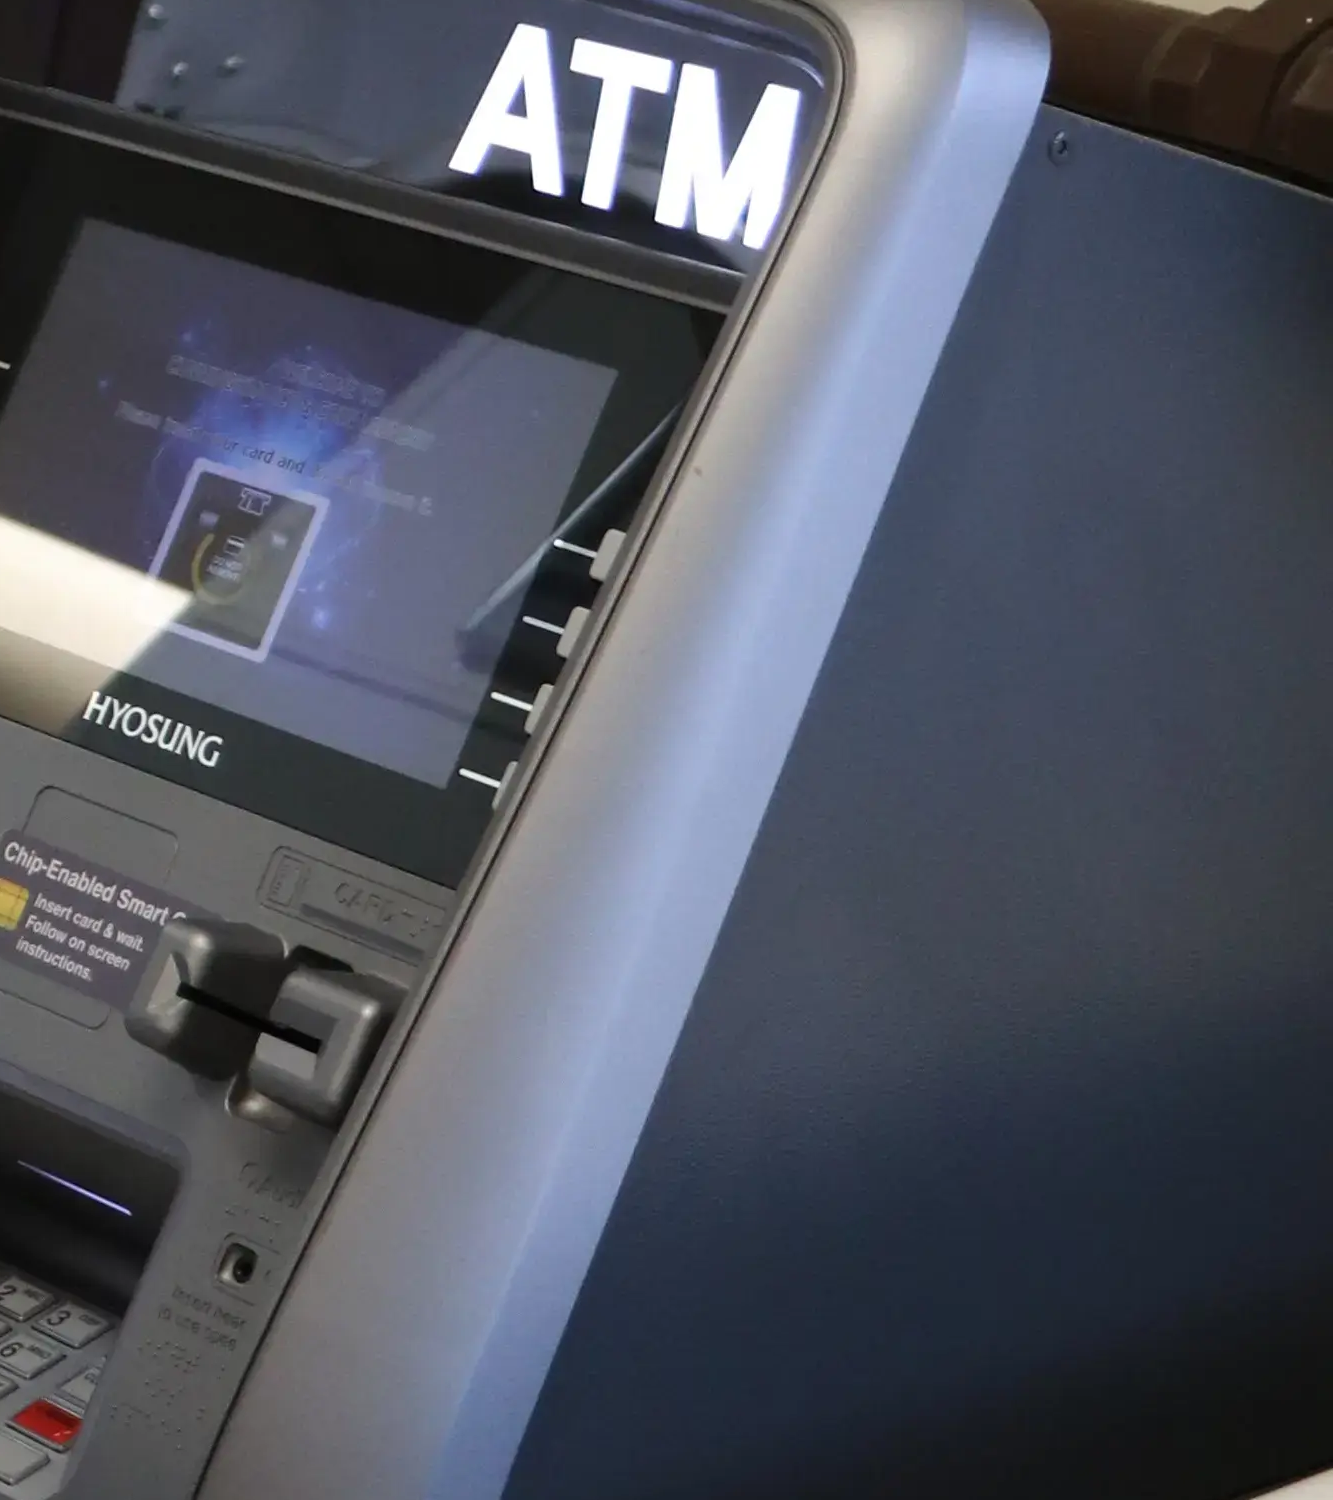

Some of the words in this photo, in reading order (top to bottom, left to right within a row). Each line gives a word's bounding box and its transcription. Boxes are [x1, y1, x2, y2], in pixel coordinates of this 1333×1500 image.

[448, 22, 802, 251] ATM
[82, 690, 225, 768] HYOSUNG
[3, 840, 117, 905] Chip-Enabled
[117, 889, 169, 926] Smart
[24, 914, 68, 944] Follow
[68, 935, 87, 952] on
[87, 942, 131, 972] screen
[34, 892, 73, 921] Insert
[73, 911, 102, 933] card
[103, 922, 114, 939] &
[116, 929, 145, 953] wait.
[14, 935, 94, 983] instructions.
[46, 1309, 71, 1326] 3
